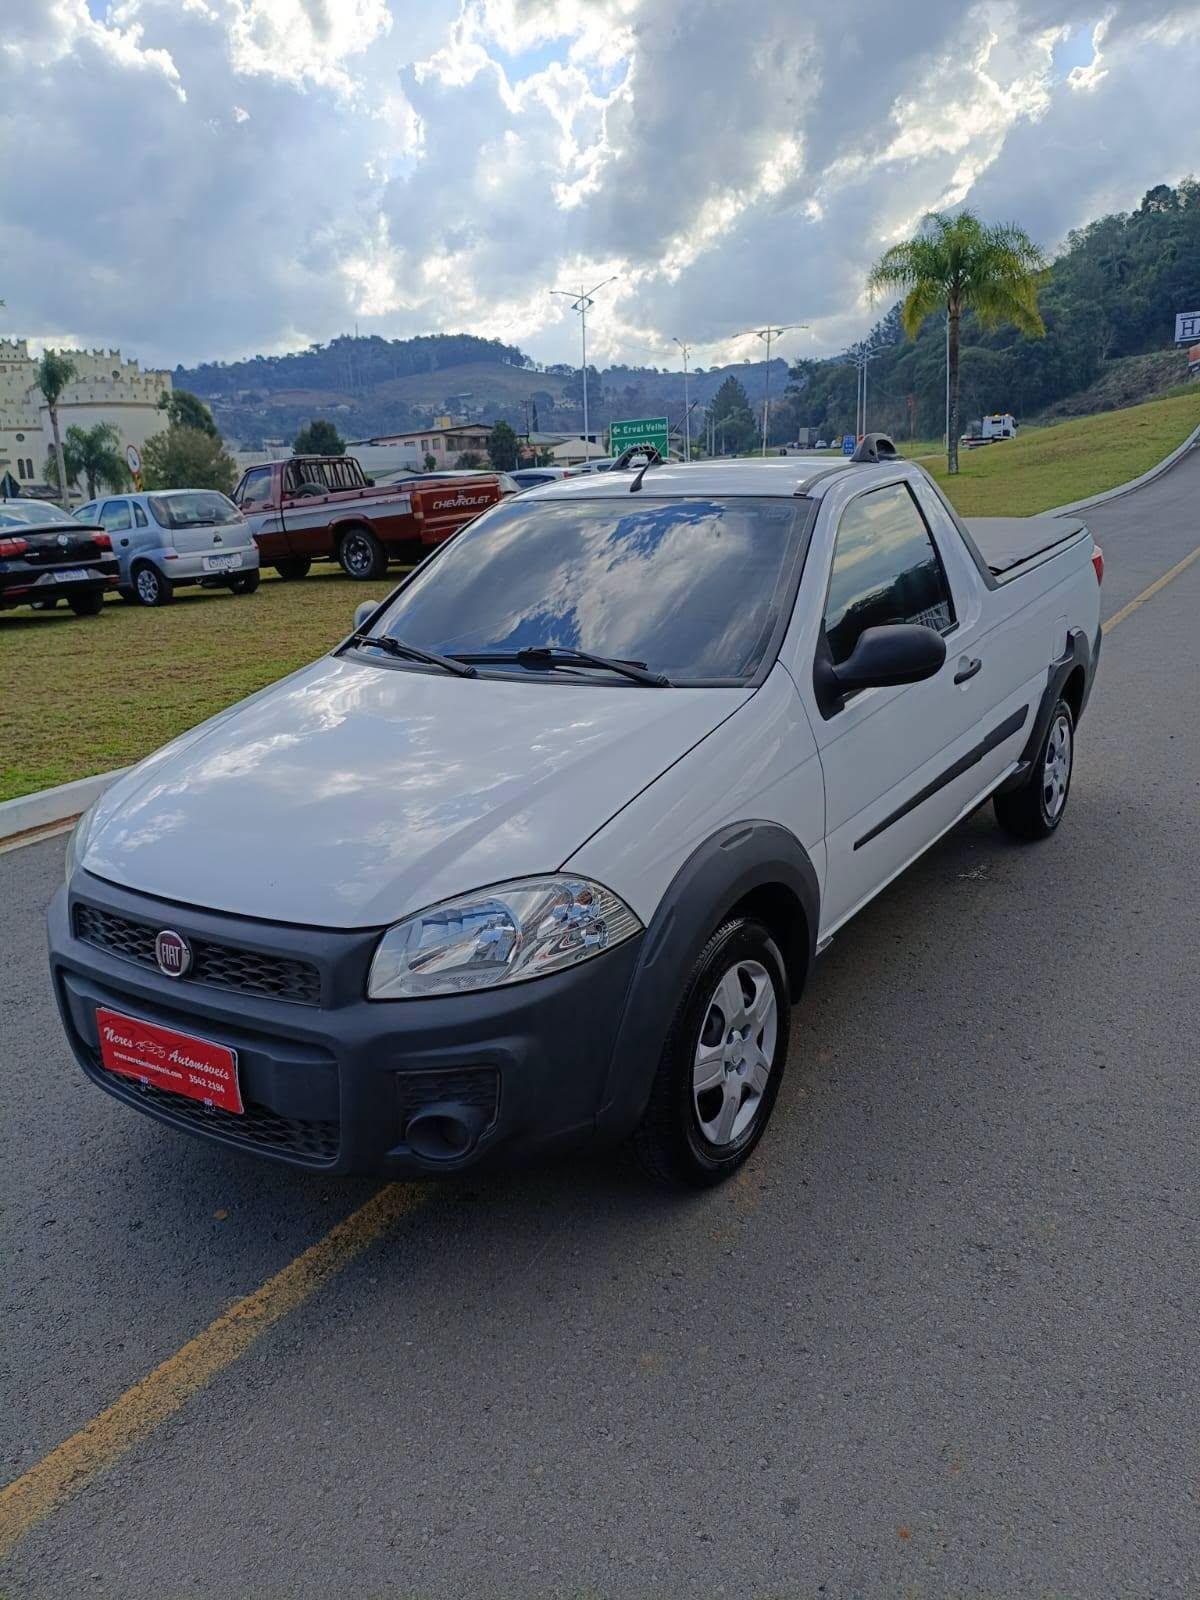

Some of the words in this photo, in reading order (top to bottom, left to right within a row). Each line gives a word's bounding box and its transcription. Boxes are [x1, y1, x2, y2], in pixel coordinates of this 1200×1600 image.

[1180, 319, 1200, 337] H
[623, 424, 644, 434] Erval
[645, 423, 667, 432] Velho
[432, 495, 491, 510] CHEVROLET
[161, 943, 180, 967] FIAT
[103, 1027, 133, 1048] Neres
